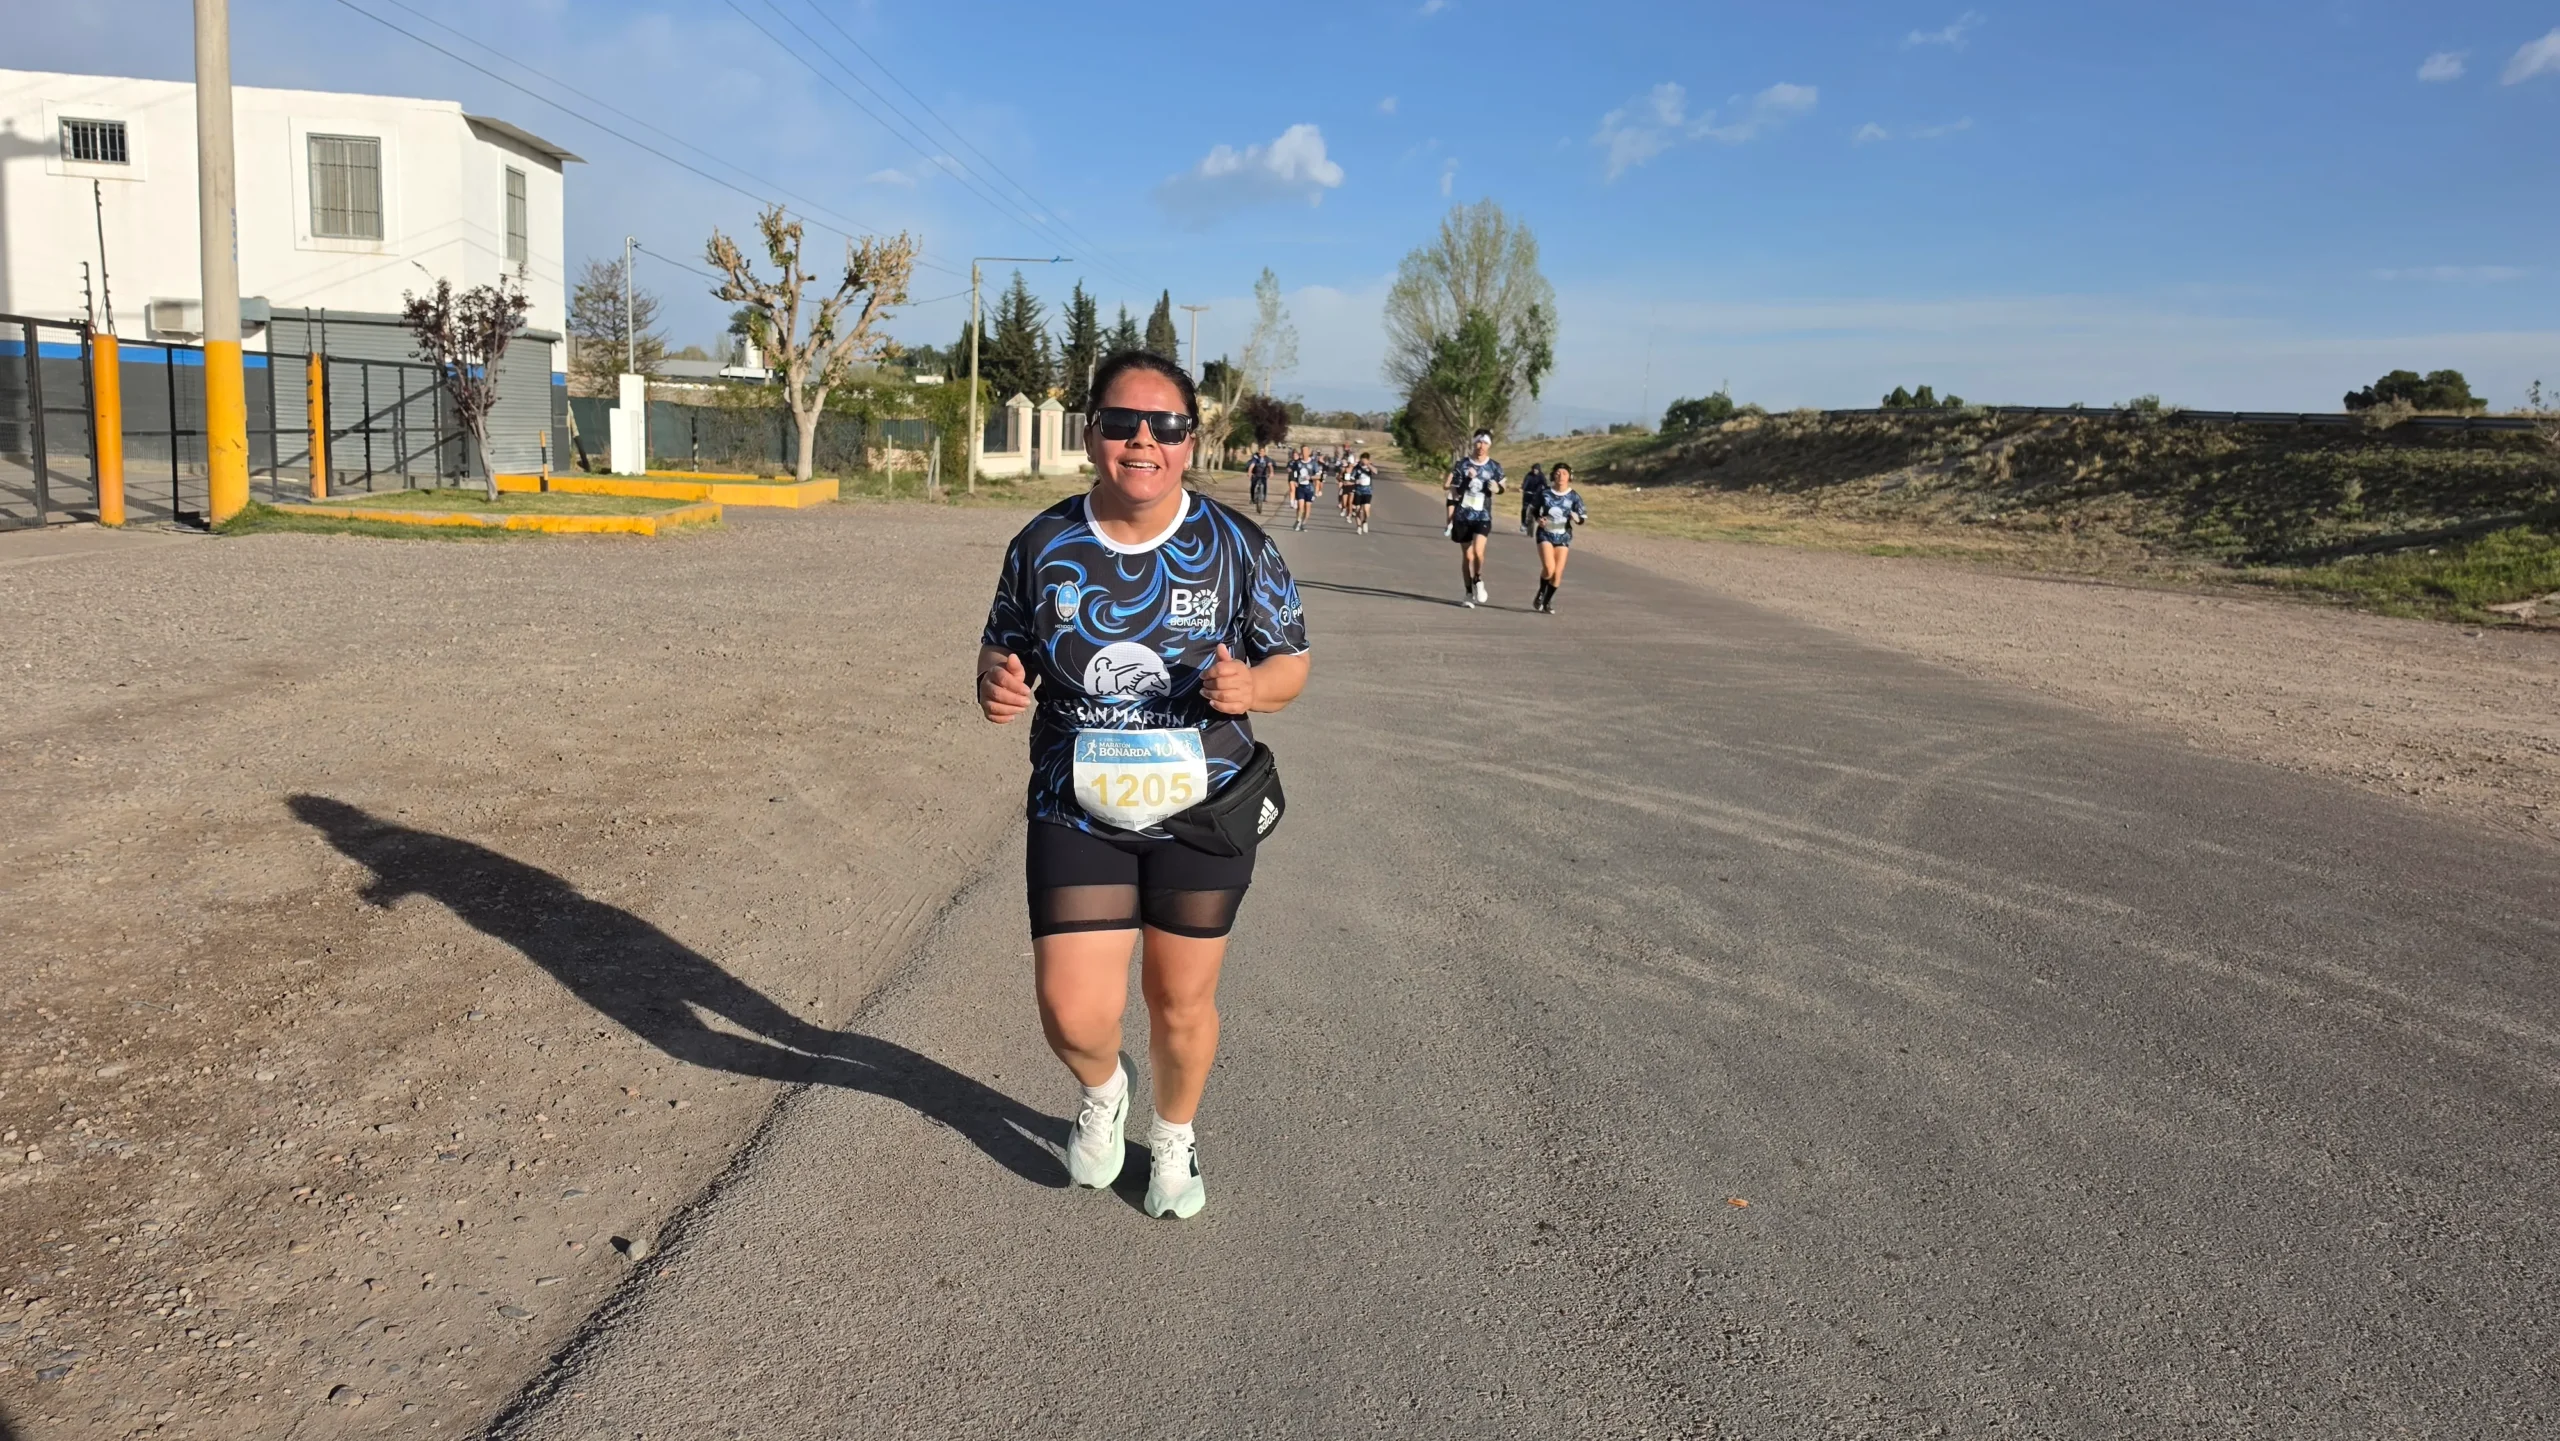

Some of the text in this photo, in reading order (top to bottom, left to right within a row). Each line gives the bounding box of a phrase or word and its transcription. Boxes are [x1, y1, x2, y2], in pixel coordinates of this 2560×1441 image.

[1170, 618, 1215, 628] BONARDA
[1077, 706, 1185, 727] SAN MARTÍN
[1099, 747, 1152, 757] BONARDA
[1091, 772, 1193, 807] 1205
[1257, 807, 1279, 834] adidas
